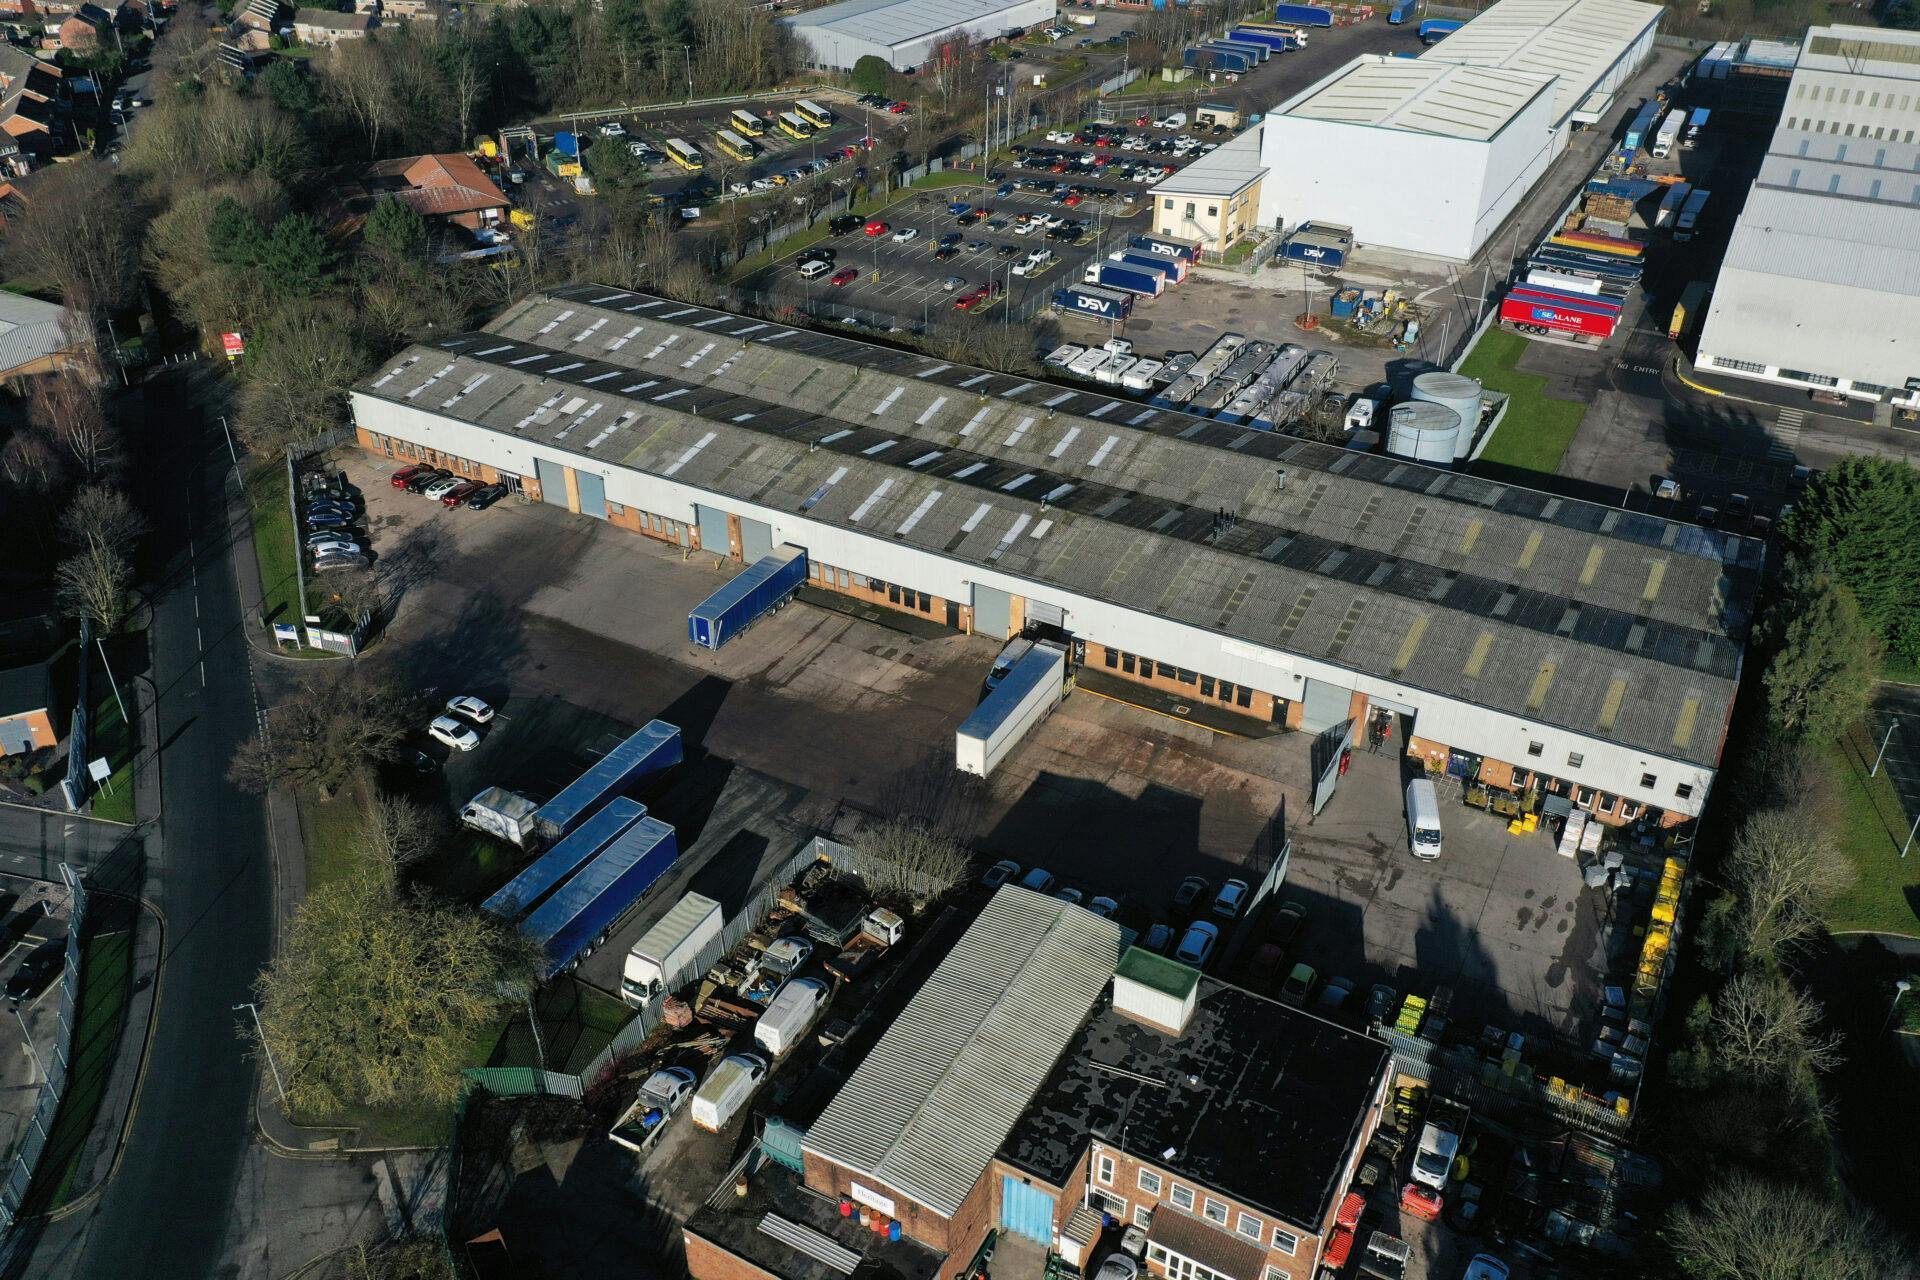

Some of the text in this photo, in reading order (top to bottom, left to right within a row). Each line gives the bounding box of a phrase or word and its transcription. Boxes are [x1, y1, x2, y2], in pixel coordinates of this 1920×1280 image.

[1151, 243, 1182, 257] DSV
[1304, 248, 1325, 258] DSV
[1077, 295, 1111, 313] DSV
[1541, 311, 1582, 323] SEALANE
[1633, 365, 1660, 375] ENTRY
